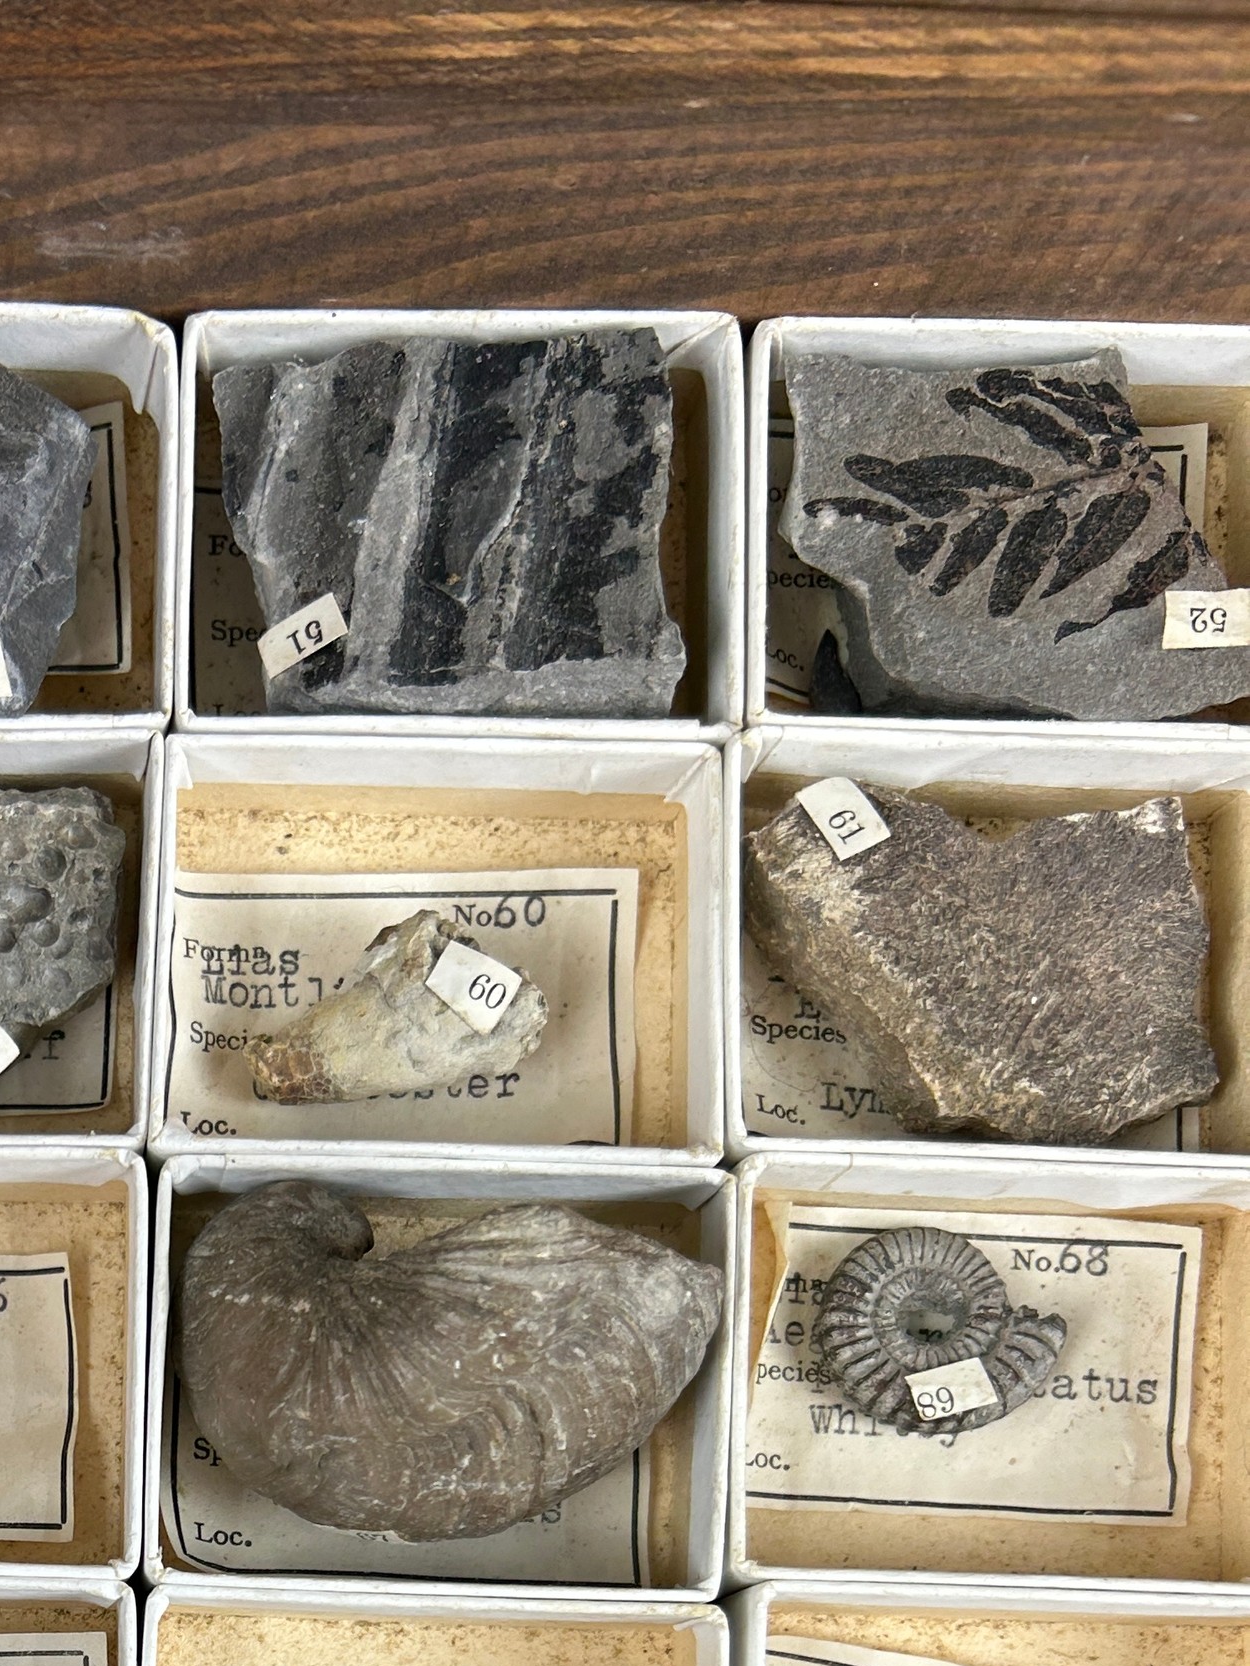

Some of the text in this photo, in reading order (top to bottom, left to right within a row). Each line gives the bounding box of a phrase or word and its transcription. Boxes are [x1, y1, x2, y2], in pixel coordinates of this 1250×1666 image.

[766, 571, 830, 592] pecie
[1189, 607, 1227, 633] 52
[286, 619, 322, 656] 51
[828, 809, 865, 845] 61
[201, 944, 301, 976] Lias
[468, 973, 507, 1009] 60
[190, 1021, 249, 1053] Speci
[756, 1094, 806, 1125] Loc.
[755, 1360, 832, 1386] pecies
[195, 1523, 252, 1548] Loc.
